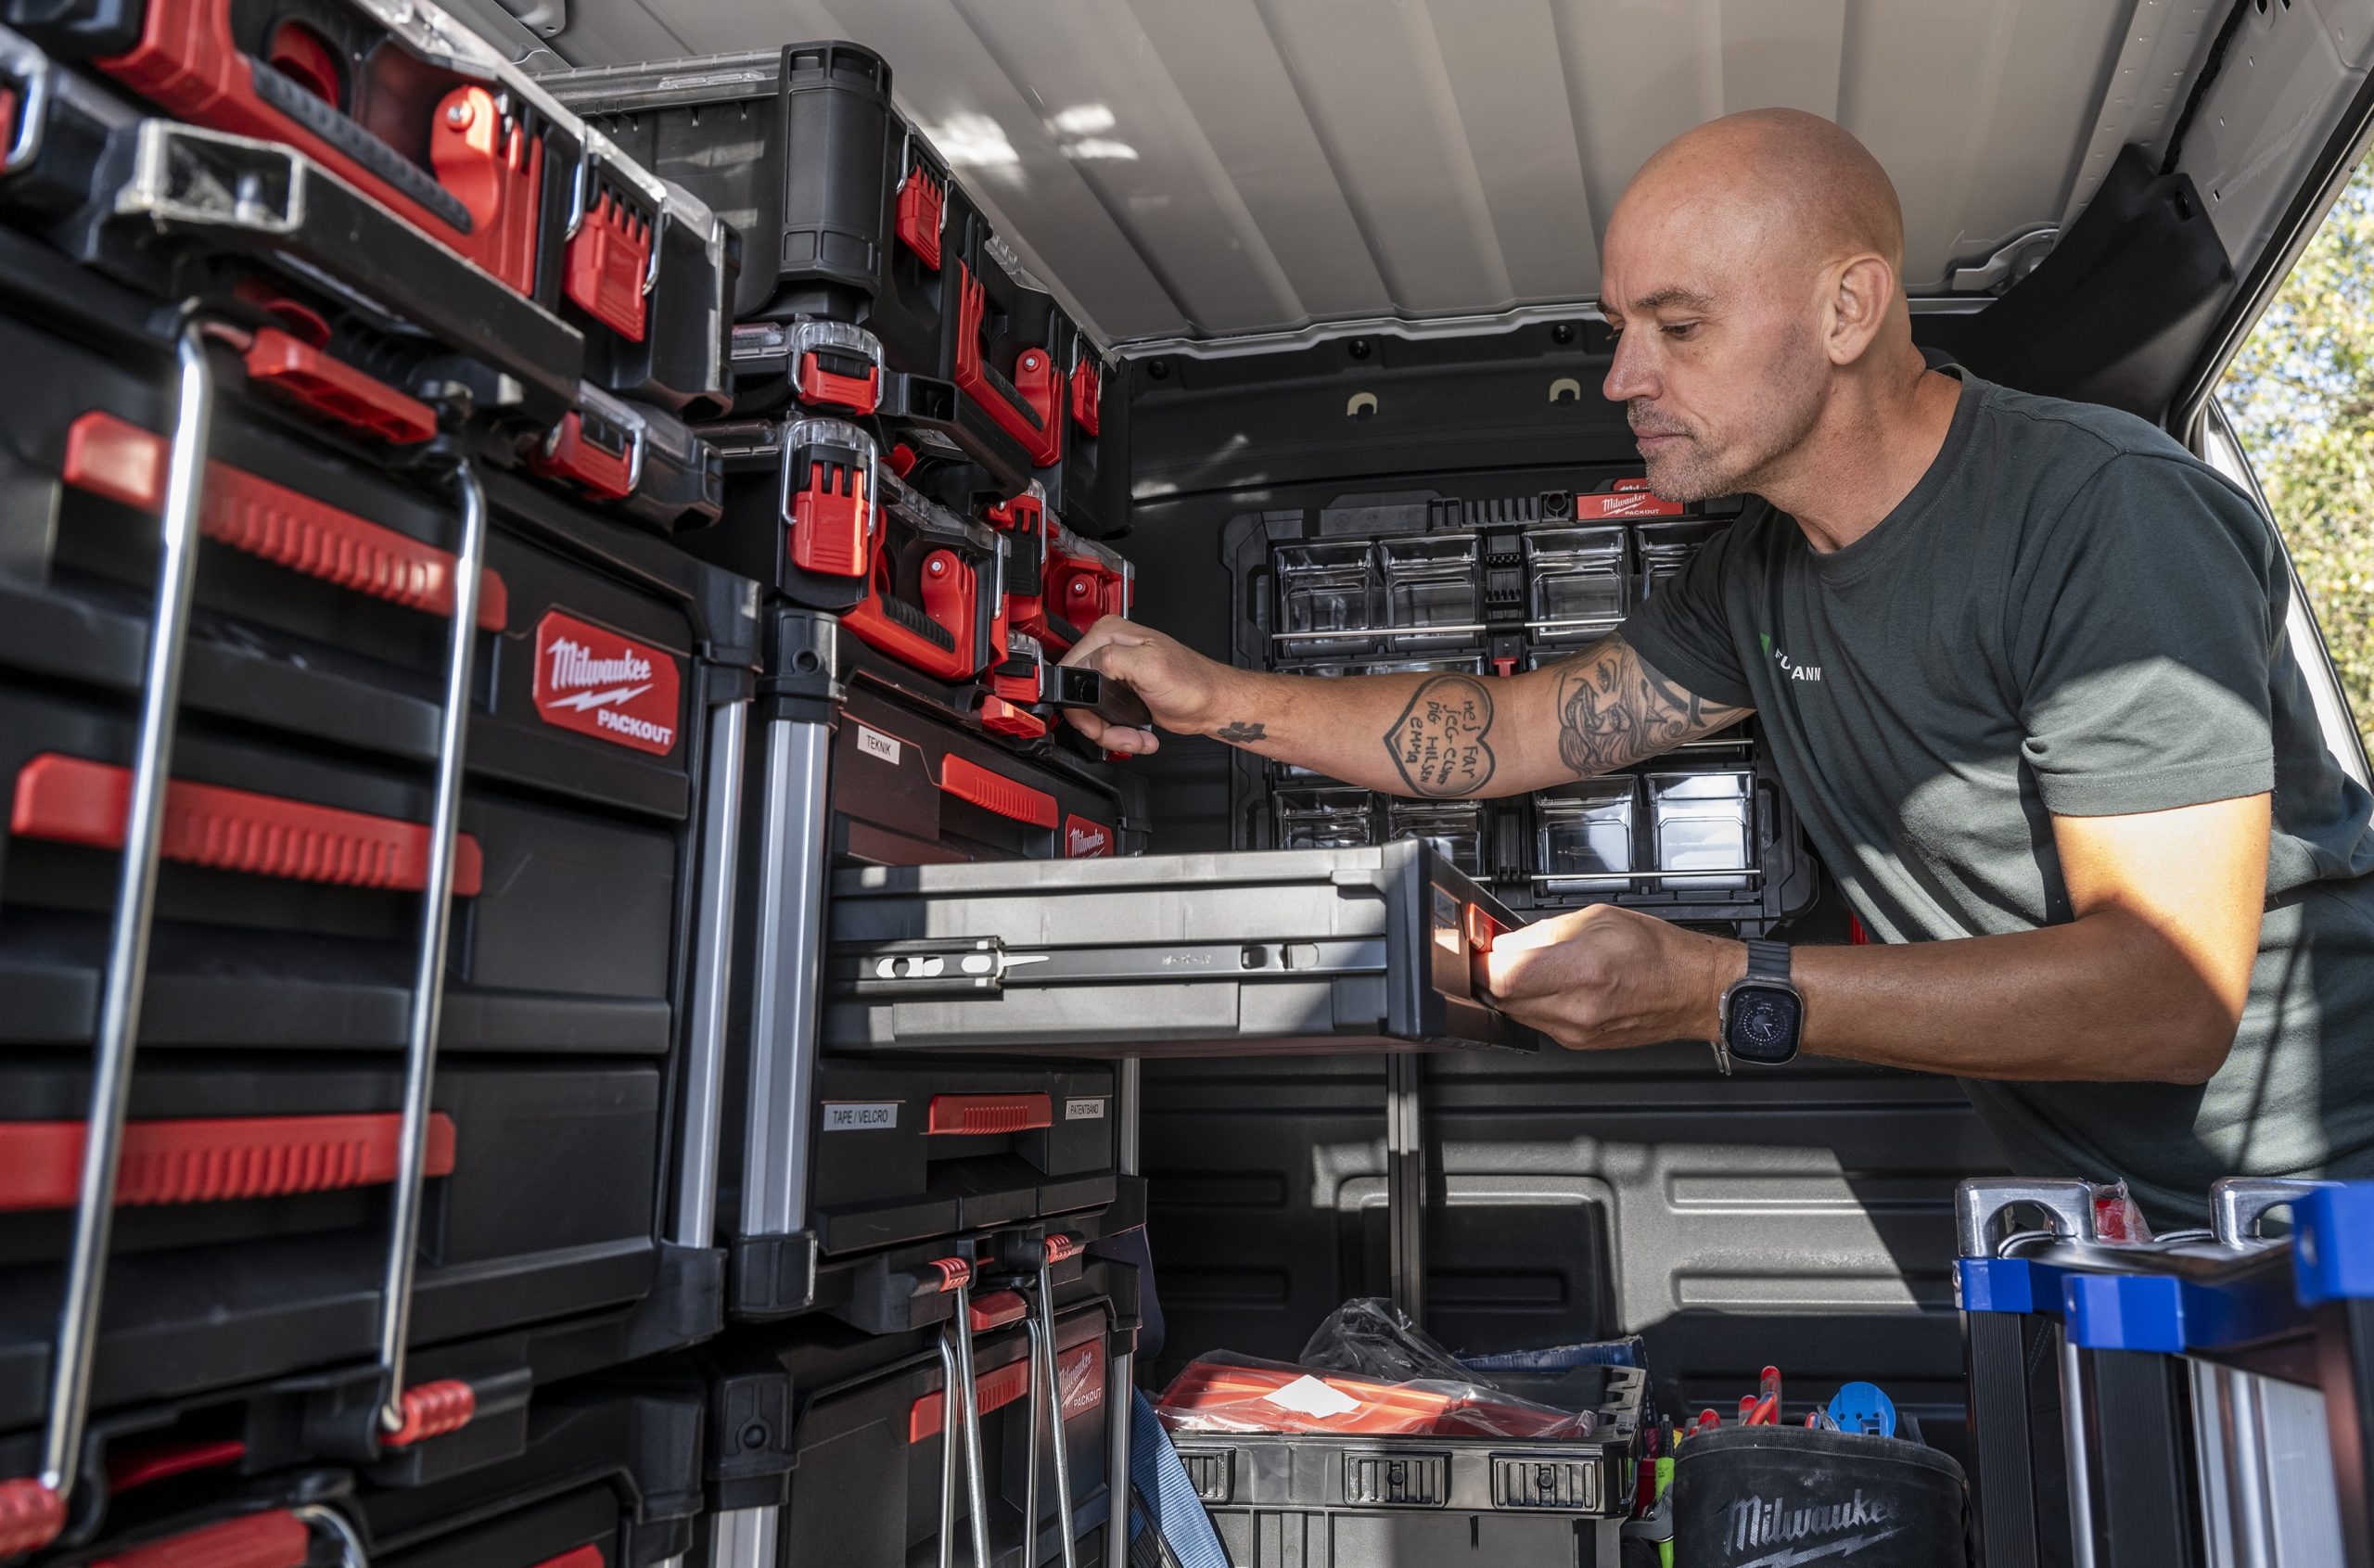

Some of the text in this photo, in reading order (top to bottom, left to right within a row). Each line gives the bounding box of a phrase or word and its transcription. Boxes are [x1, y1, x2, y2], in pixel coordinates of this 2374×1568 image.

[1602, 494, 1647, 512] Milwaukee
[546, 636, 653, 693] Milwaukee
[597, 708, 672, 746] PACKOUT
[866, 734, 891, 757] TEKNIK
[1069, 827, 1104, 858] Milwaukee
[834, 1110, 852, 1125] TAPE
[859, 1109, 888, 1124] VELCRO
[1073, 1387, 1102, 1409] PACKOUT
[1717, 1488, 1901, 1557] Milwaukee
